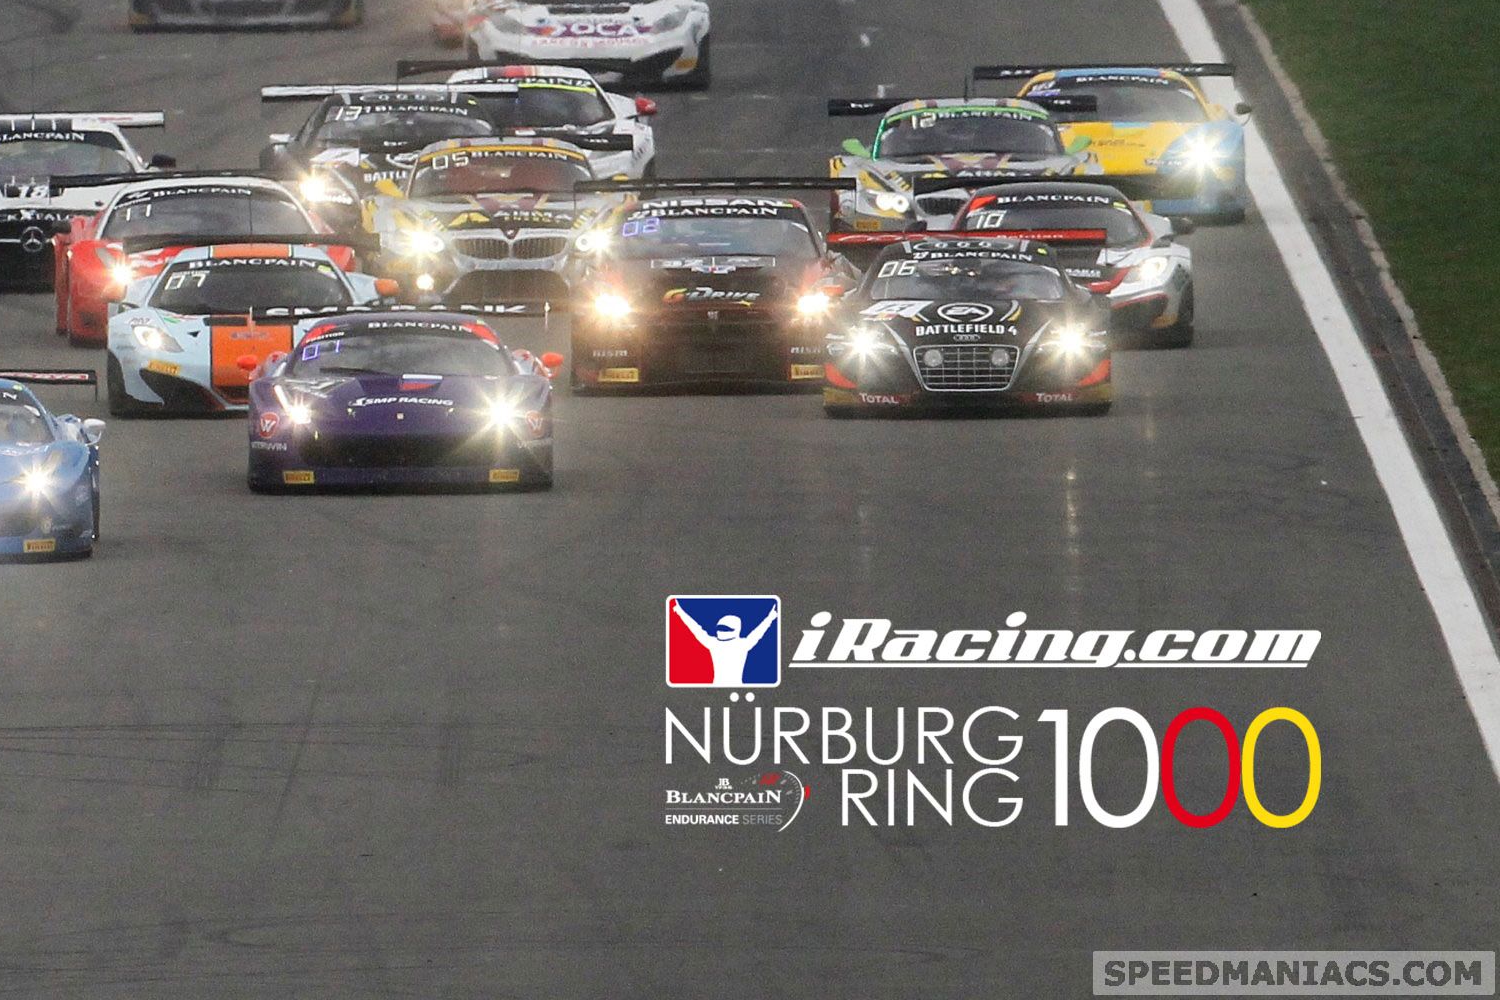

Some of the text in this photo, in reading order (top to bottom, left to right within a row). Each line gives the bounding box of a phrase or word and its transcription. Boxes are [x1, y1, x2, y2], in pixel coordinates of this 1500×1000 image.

[371, 105, 469, 115] BLANCPAIN
[911, 113, 936, 129] 12
[432, 150, 568, 169] 05 BLANCPAIN
[18, 184, 52, 199] 18
[152, 186, 252, 196] BLANCPAIN
[642, 199, 787, 209] NISSAN
[997, 194, 1110, 204] BLANCPAIN
[651, 206, 778, 217] BLANCPAIN
[975, 210, 1007, 229] 10
[931, 250, 1032, 261] BLANCPAIN
[188, 257, 317, 269] BLANCPAIN
[878, 260, 919, 279] 06
[164, 272, 211, 290] 07
[368, 320, 473, 333] BLANCPAIN
[915, 324, 1018, 337] BATTLEFIELD 4
[364, 397, 454, 407] SMP RACING
[859, 392, 900, 404] TOTAL
[1036, 392, 1074, 402] TOTAL
